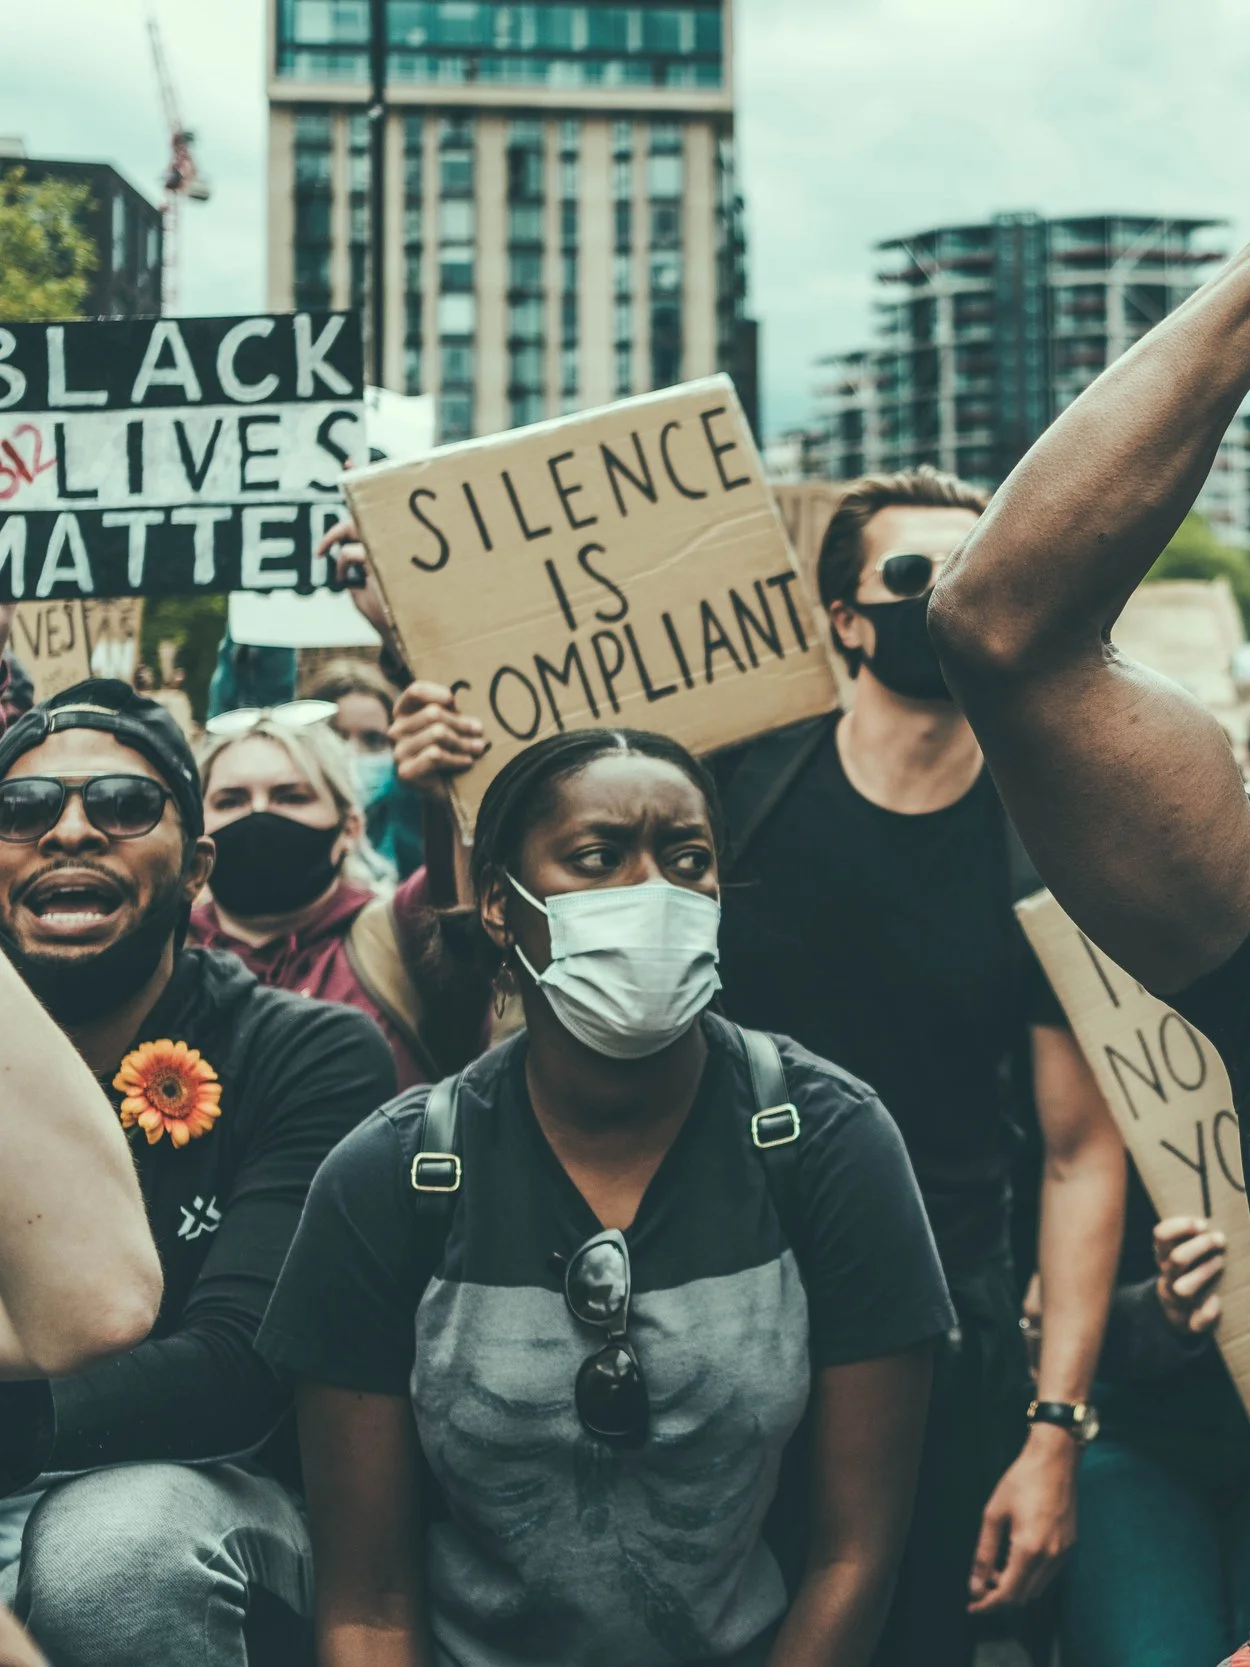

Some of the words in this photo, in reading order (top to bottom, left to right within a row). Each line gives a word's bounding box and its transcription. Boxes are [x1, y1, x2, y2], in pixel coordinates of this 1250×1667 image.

[55, 410, 359, 498] LIVES
[408, 407, 751, 572] SILENCE
[544, 543, 629, 632] IS
[449, 570, 810, 744] OMPLIANT
[1103, 1011, 1207, 1121] NO
